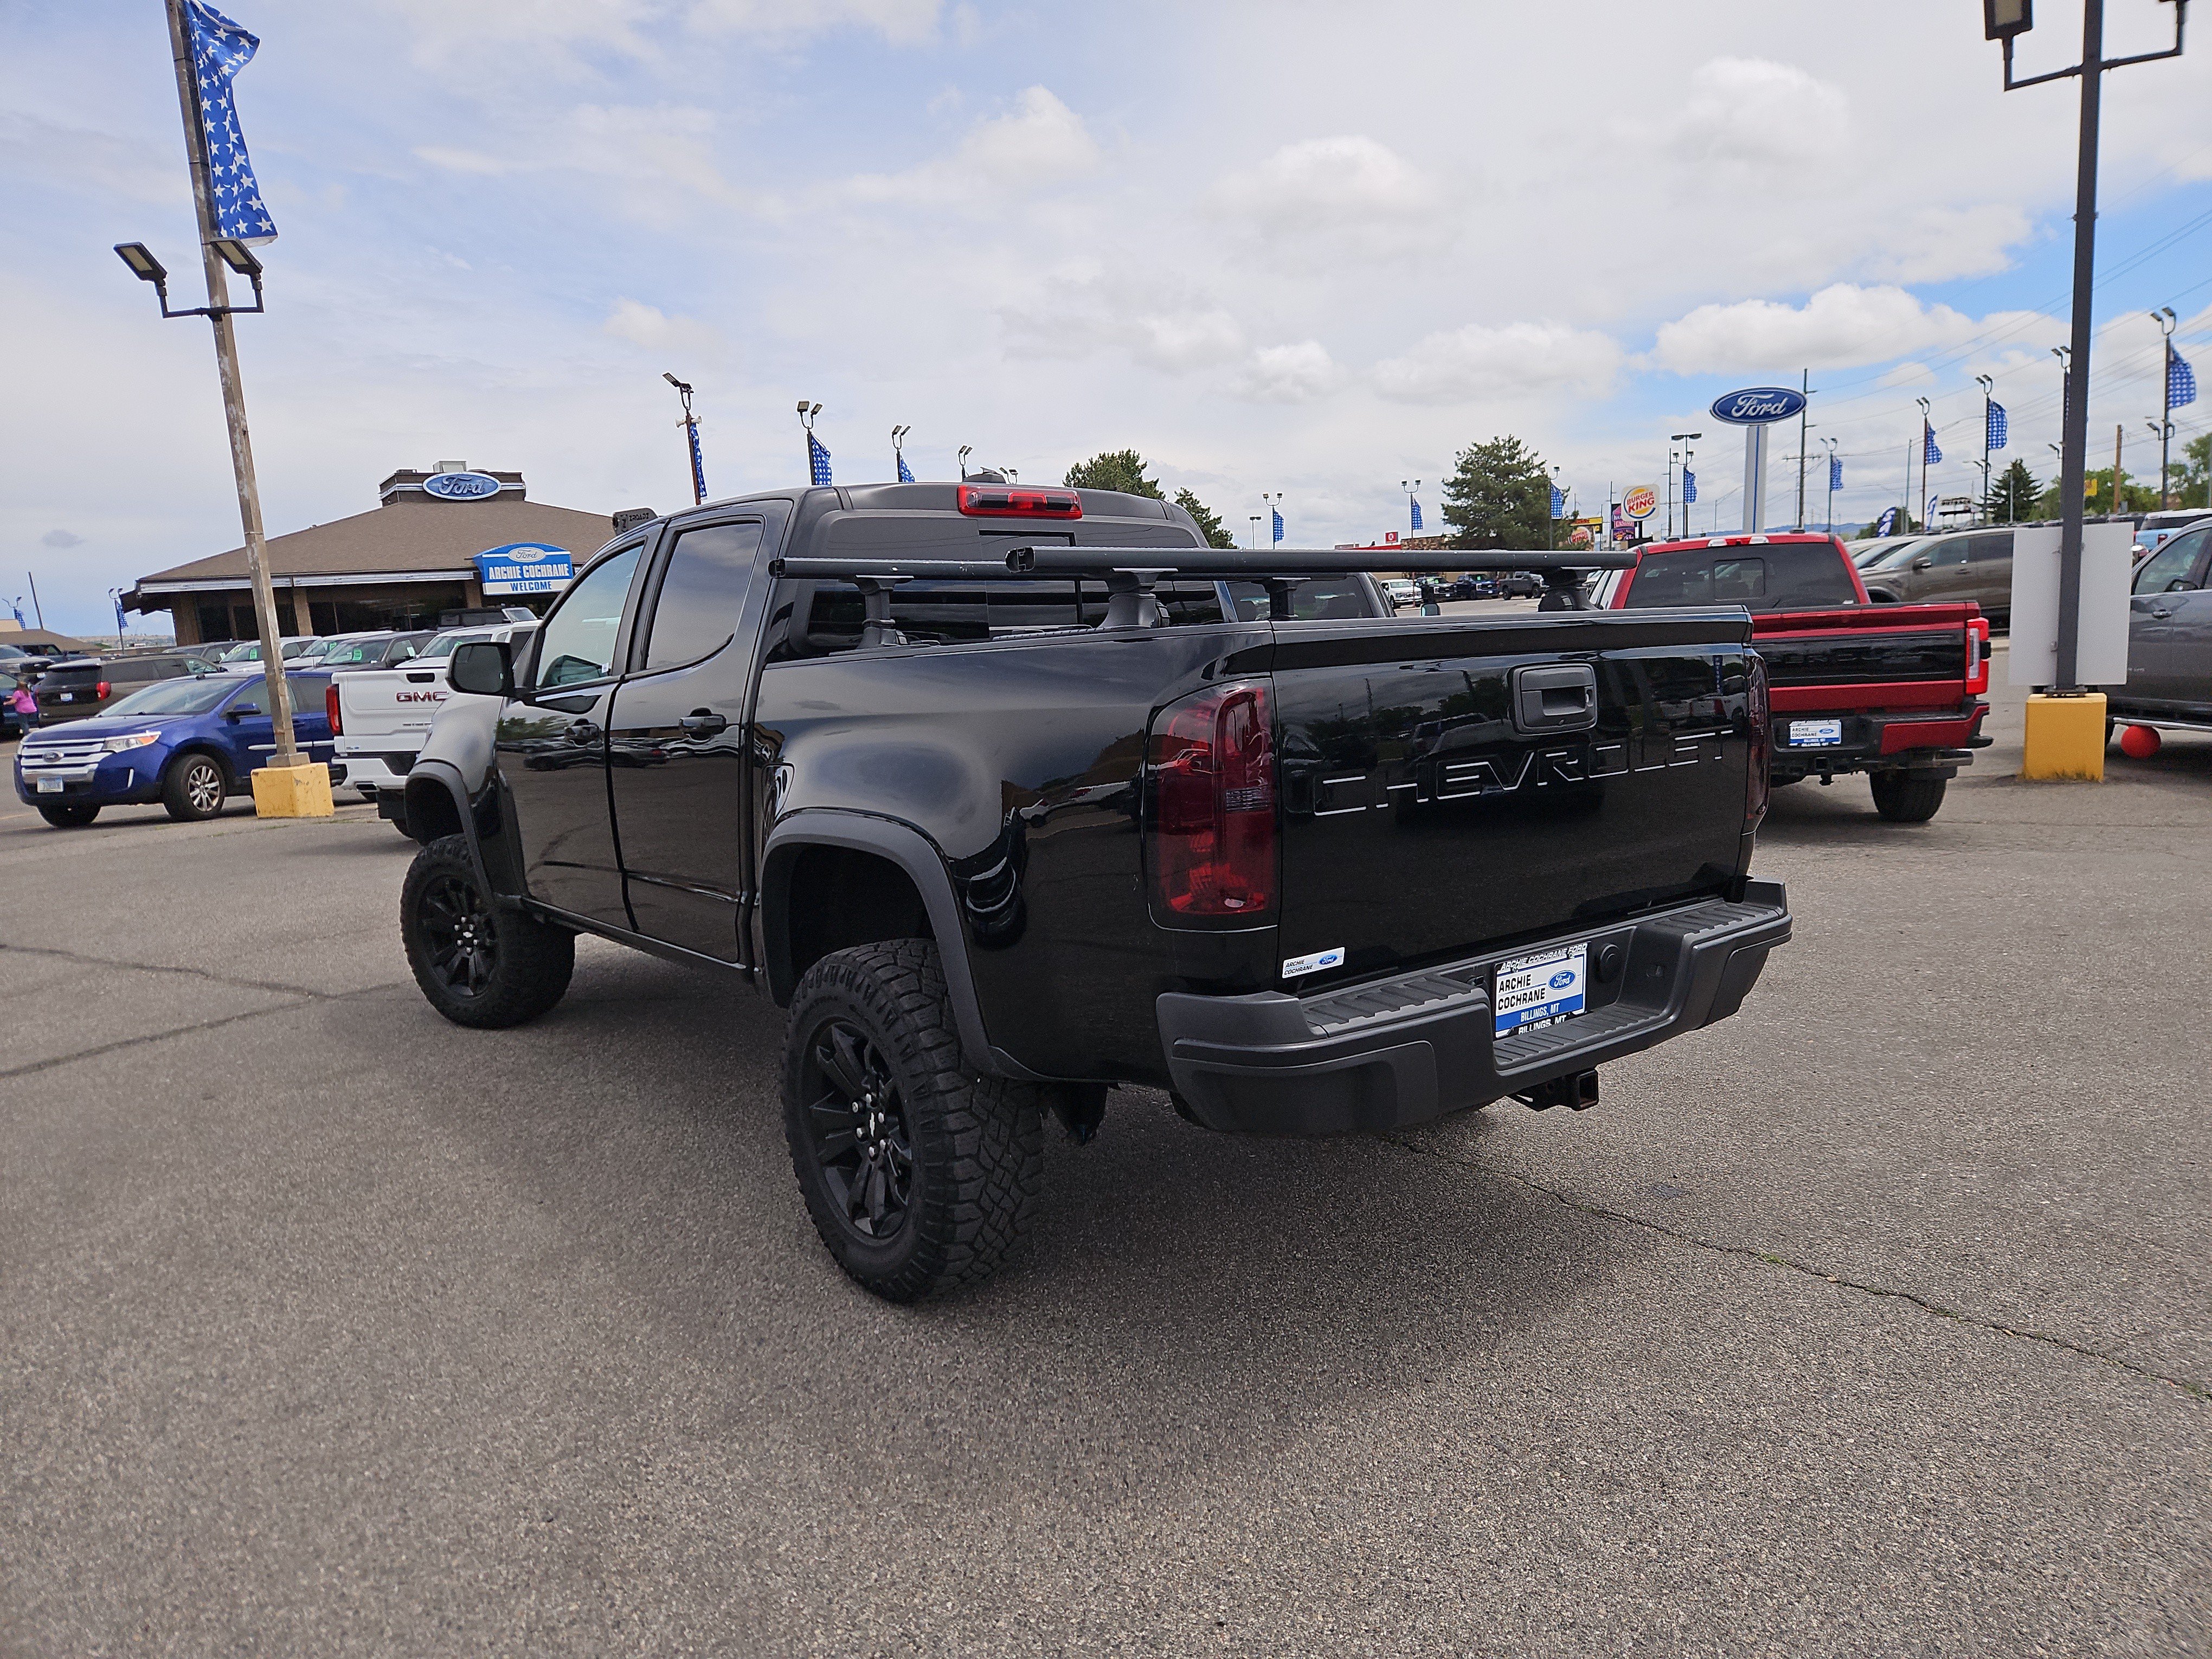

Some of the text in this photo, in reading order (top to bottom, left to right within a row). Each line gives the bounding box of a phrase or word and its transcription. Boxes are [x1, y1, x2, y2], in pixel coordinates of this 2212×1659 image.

[1731, 392, 1789, 417] Ford
[439, 476, 485, 494] Ford
[1626, 491, 1654, 505] BURGER
[1628, 497, 1655, 513] KING
[516, 549, 537, 559] Ford
[489, 563, 569, 580] ARCHIE COCHRANE
[510, 581, 552, 591] WELCOME
[396, 690, 449, 702] GMC
[1313, 726, 1735, 816] CHEVROLET
[1285, 956, 1336, 968] ARCHIE Ford
[1500, 943, 1588, 971] ARCHIE COCHRANE FORD
[1284, 964, 1314, 975] COCHRANE
[1499, 973, 1571, 993] ARCHIE Ford
[1498, 988, 1546, 1011] COCHRANE
[1520, 1002, 1560, 1023] BILLINGS, MT
[1554, 1014, 1567, 1025] MT
